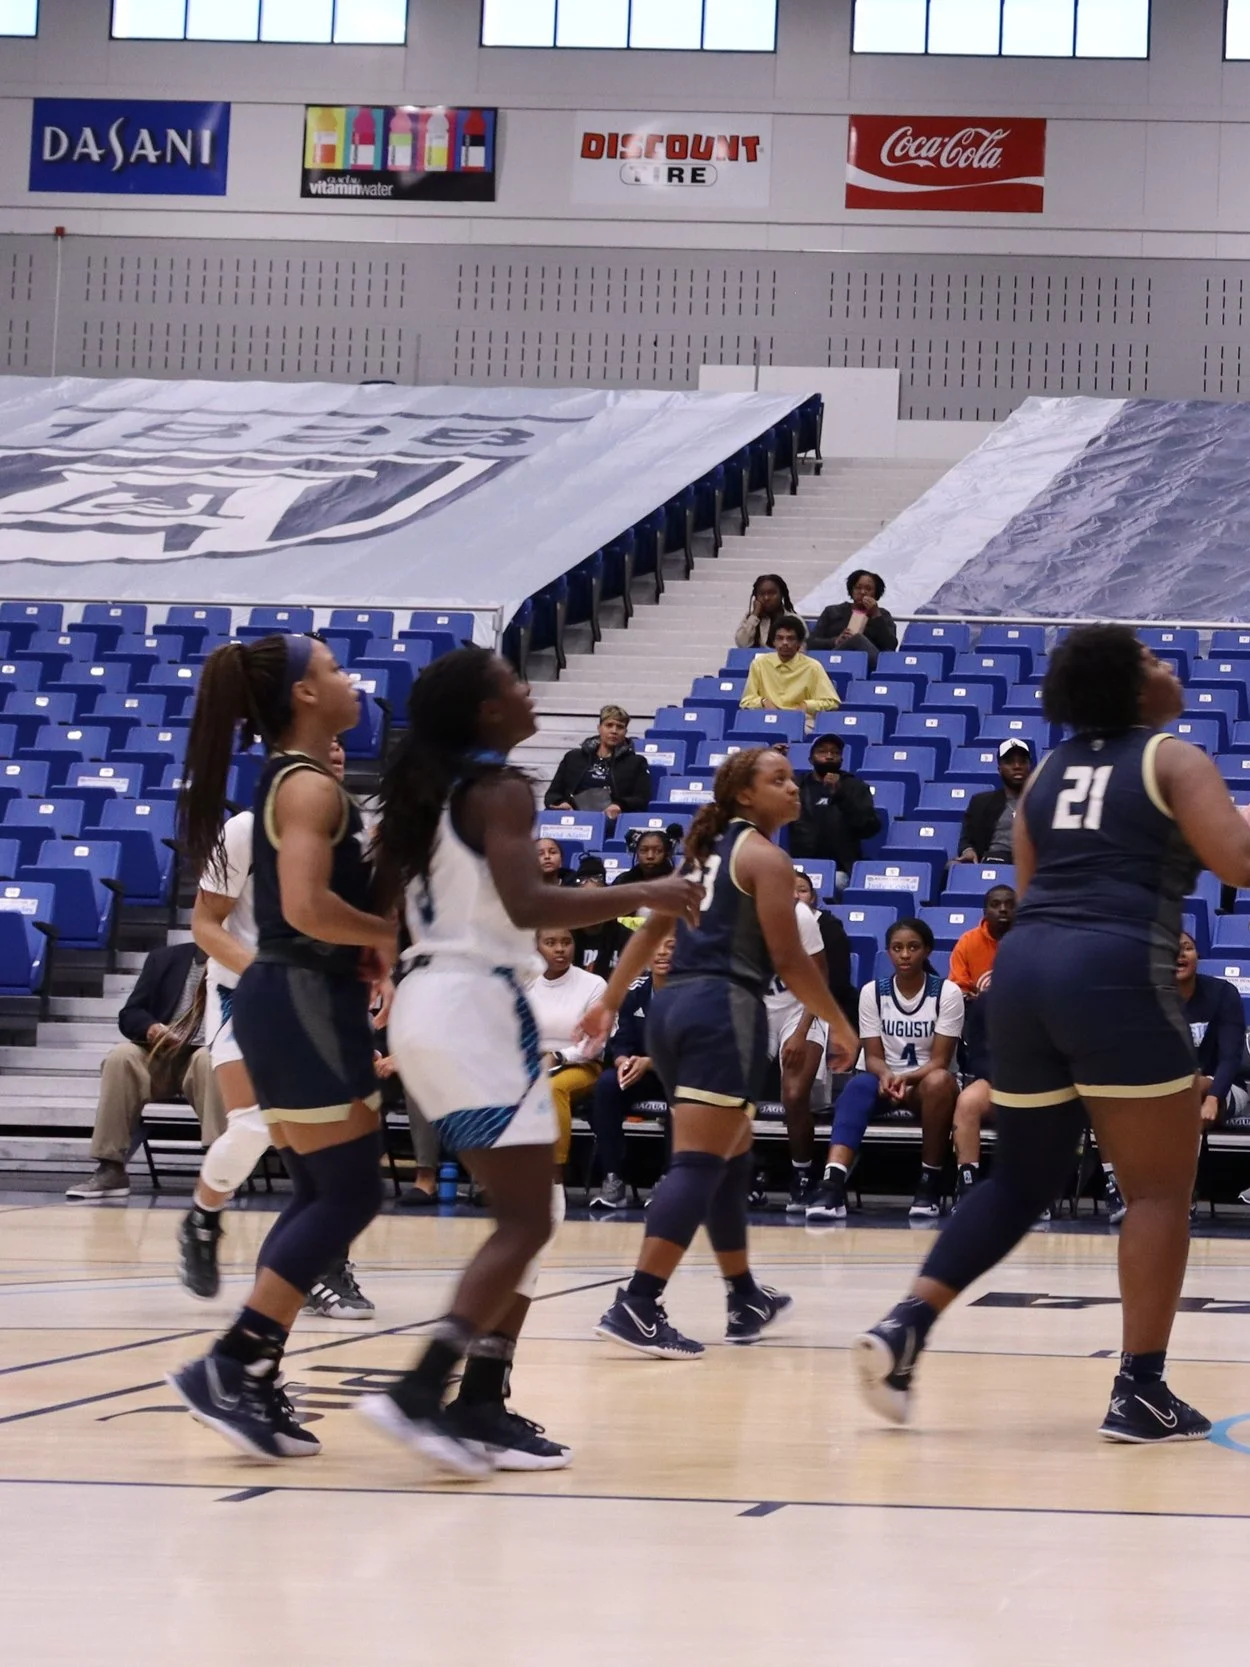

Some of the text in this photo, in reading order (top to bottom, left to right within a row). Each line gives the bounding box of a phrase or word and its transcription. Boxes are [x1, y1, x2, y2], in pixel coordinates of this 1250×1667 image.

[42, 117, 212, 171] DASANI
[580, 131, 760, 163] DISCOUNT
[880, 126, 1011, 169] Coca-Cola
[309, 180, 394, 196] vitaminwater
[1052, 765, 1114, 830] 21
[882, 1019, 935, 1038] AUGUSTA
[901, 1043, 919, 1067] 4
